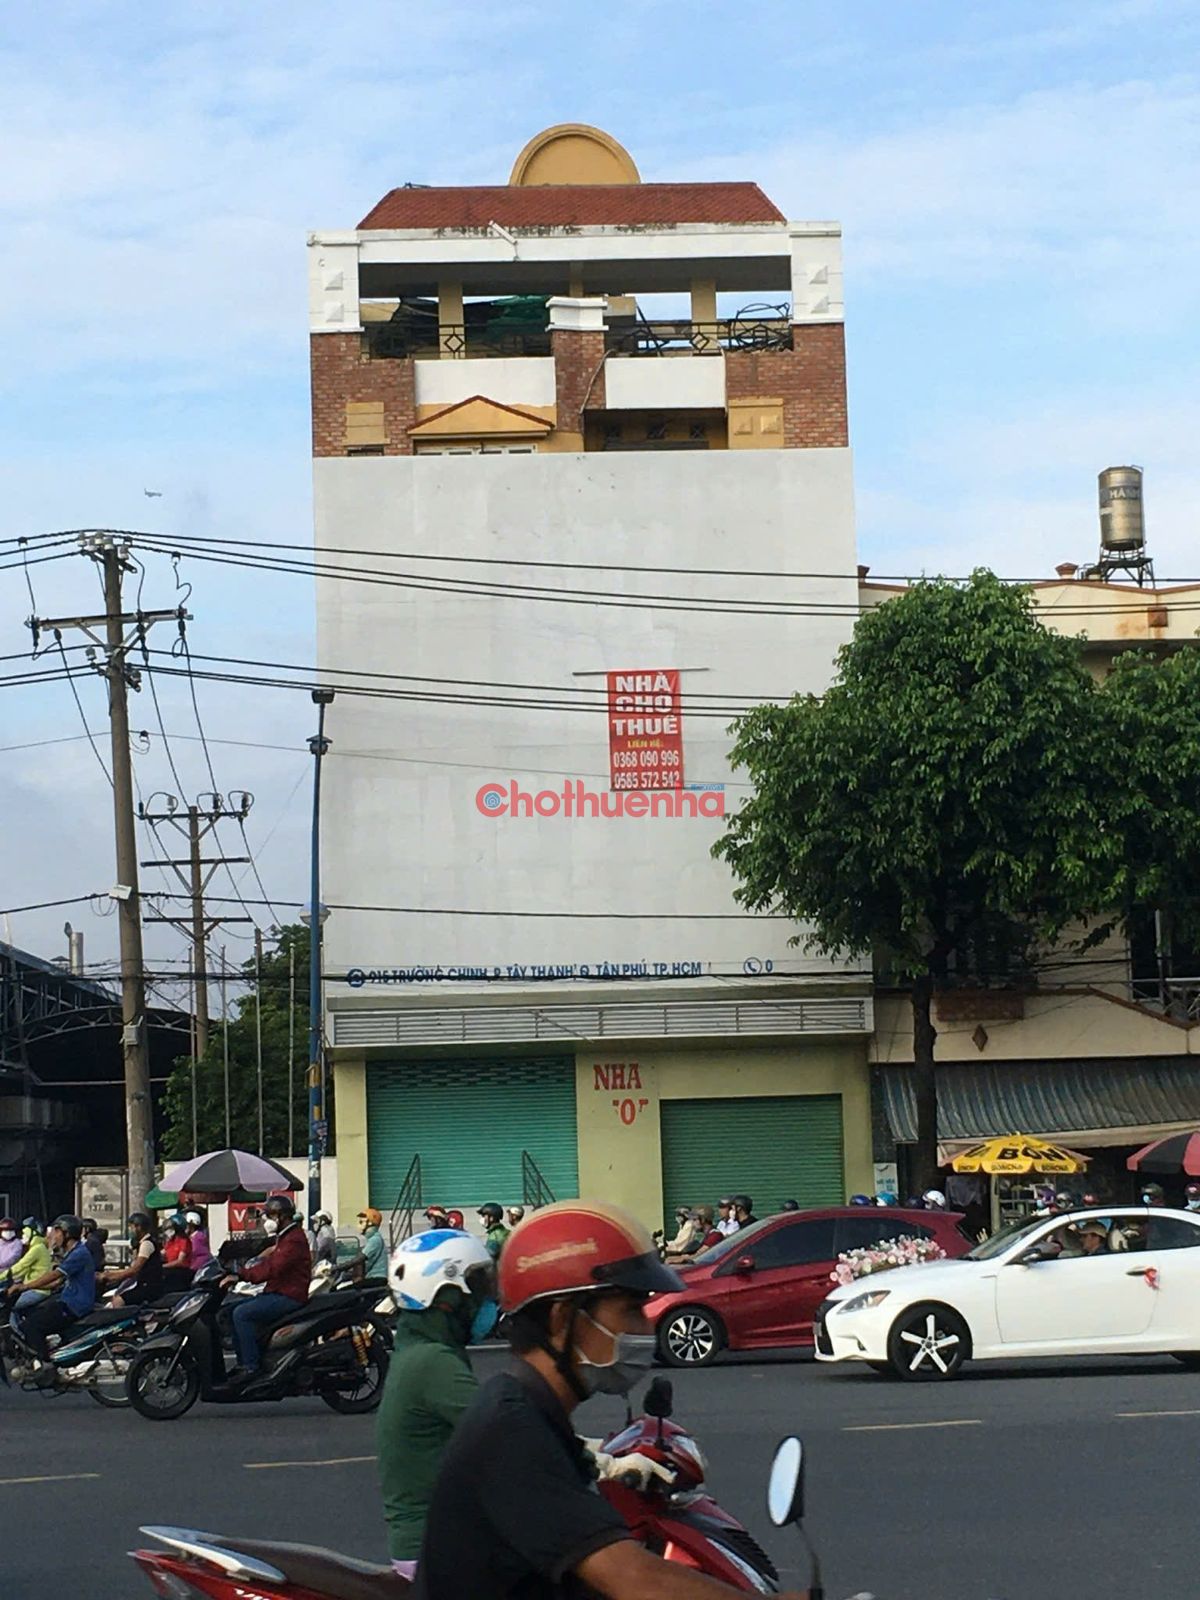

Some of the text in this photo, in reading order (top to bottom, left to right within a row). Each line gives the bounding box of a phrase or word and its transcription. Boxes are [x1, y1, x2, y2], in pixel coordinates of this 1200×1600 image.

[615, 671, 671, 693] NHÀ
[615, 694, 673, 713] CHO
[612, 714, 678, 736] THUÊ
[613, 751, 638, 768] 0368
[640, 750, 659, 767] 090
[640, 771, 660, 788] 572
[672, 960, 700, 975] HCM
